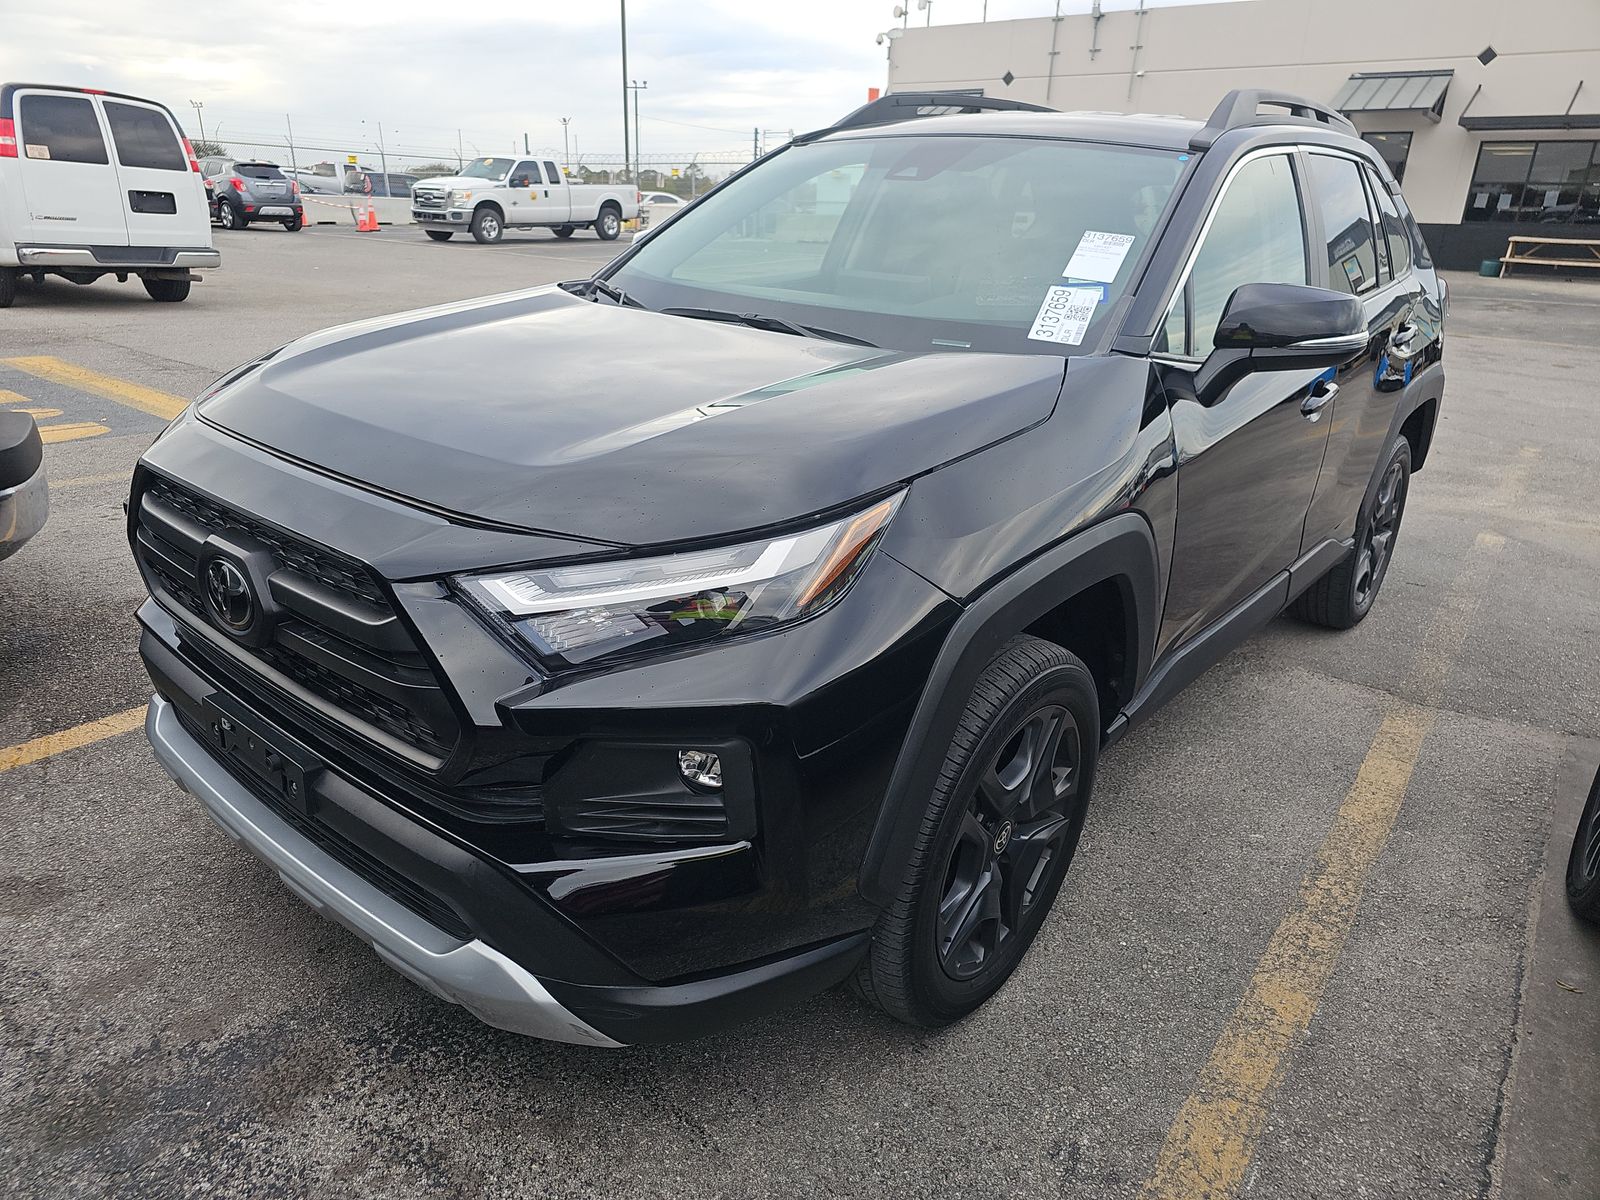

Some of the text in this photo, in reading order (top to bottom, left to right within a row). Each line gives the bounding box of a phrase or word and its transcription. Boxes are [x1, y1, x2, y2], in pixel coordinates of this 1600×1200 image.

[1083, 231, 1133, 244] 3137659
[1035, 289, 1072, 338] 3137659
[1060, 328, 1073, 343] DLR
